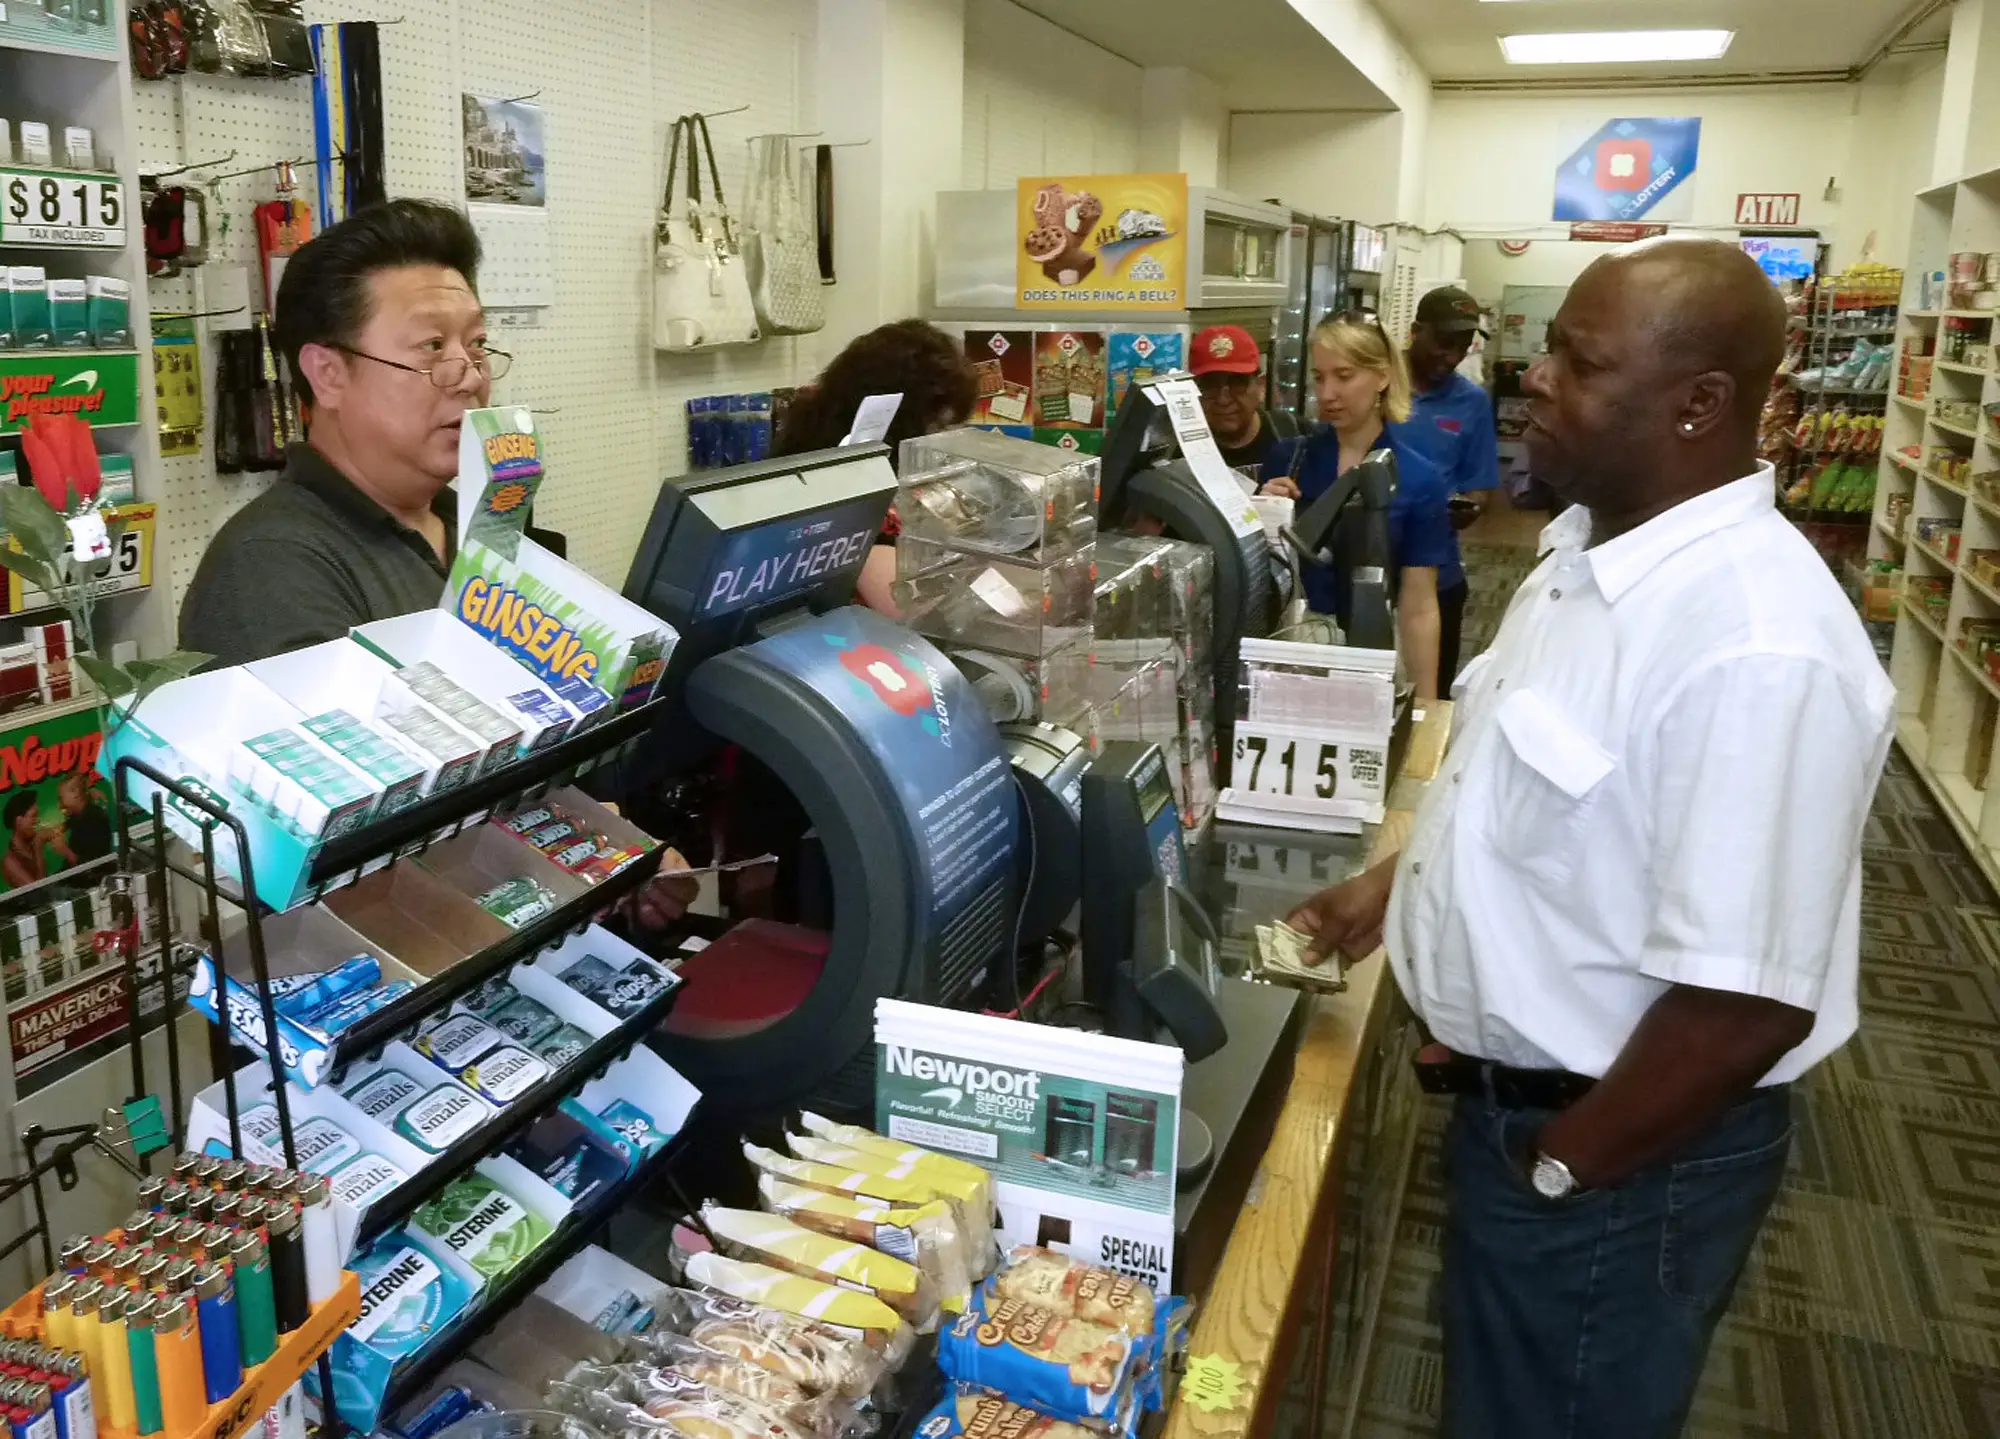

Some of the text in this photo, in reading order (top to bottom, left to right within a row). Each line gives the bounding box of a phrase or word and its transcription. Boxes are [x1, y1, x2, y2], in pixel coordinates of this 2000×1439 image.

[9, 177, 120, 226] $8.15
[1632, 165, 1677, 207] LOTTERY
[1738, 196, 1798, 223] ATM
[28, 228, 105, 242] TAX INCLUDED
[1023, 289, 1177, 302] DOES THIS RING A BELL?
[1, 374, 55, 402] your
[8, 388, 105, 422] pleasure!
[483, 432, 537, 465] GINSENG
[703, 529, 873, 611] PLAY HERE!
[461, 576, 598, 680] GINSENG
[0, 734, 104, 791] Newp
[1236, 736, 1338, 799] $7.15
[19, 975, 123, 1038] MAVERICK
[607, 972, 653, 1009] eclipse
[23, 1000, 123, 1054] THE REAL DEAL
[438, 1021, 487, 1056] smalls
[485, 1053, 532, 1089] smalls
[885, 1044, 1041, 1100] Newport
[363, 1080, 416, 1119] smalls
[421, 1093, 471, 1134] smalls
[975, 1090, 1036, 1111] SMOOTH
[975, 1102, 1035, 1122] SELECT
[295, 1131, 344, 1164] malls
[445, 1197, 512, 1252] ISTERINE
[1101, 1234, 1168, 1273] SPECIAL
[976, 1298, 1026, 1346] Crum
[1009, 1307, 1052, 1346] Cake
